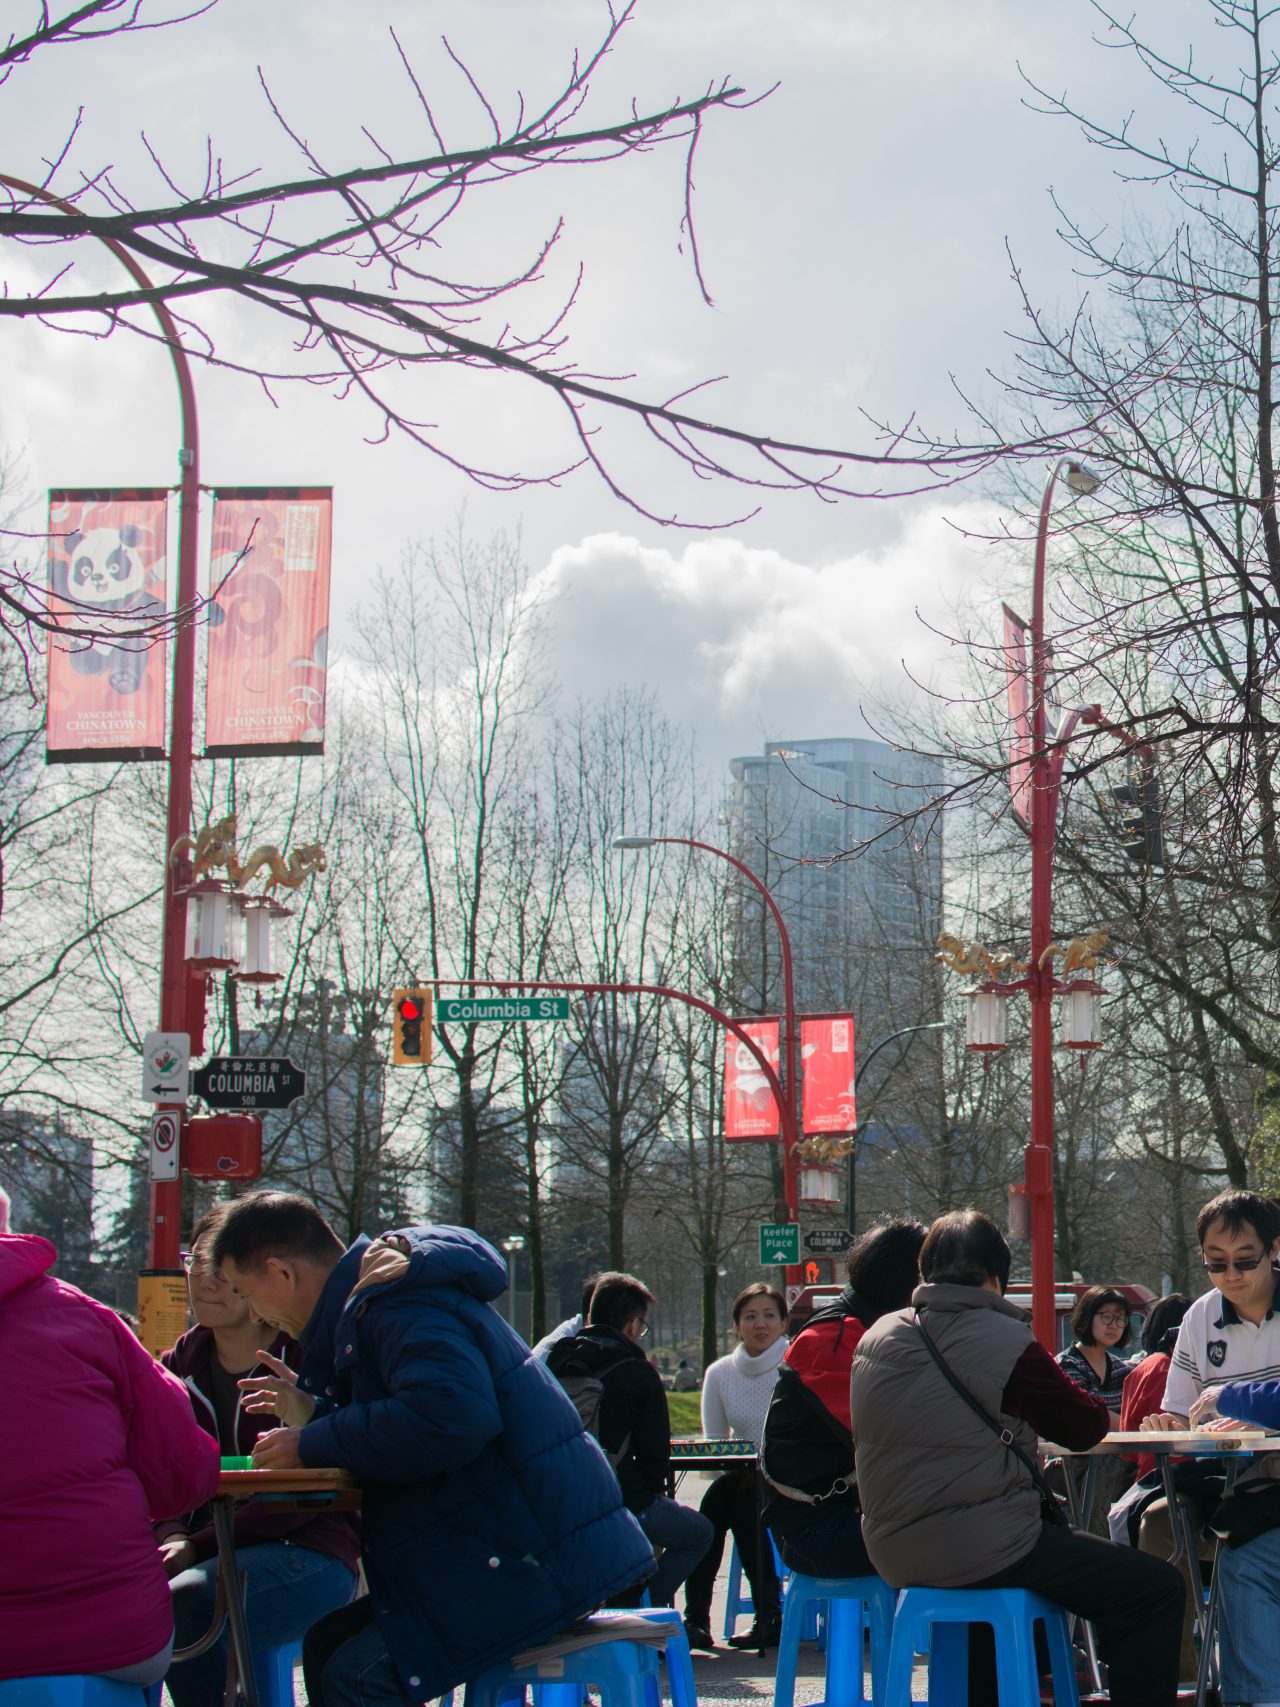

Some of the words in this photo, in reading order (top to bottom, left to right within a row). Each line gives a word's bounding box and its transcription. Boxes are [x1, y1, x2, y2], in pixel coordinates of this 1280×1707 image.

[76, 710, 135, 719] VANCOUVER
[66, 719, 147, 731] CHINATOWN
[225, 715, 305, 728] CHINATOWN
[447, 1002, 531, 1018] Columbia
[539, 1001, 559, 1017] St
[208, 1074, 276, 1093] COLUMBIA
[281, 1075, 291, 1085] ST
[241, 1096, 256, 1106] 500
[763, 1227, 796, 1237] Keefer
[766, 1239, 793, 1248] Place
